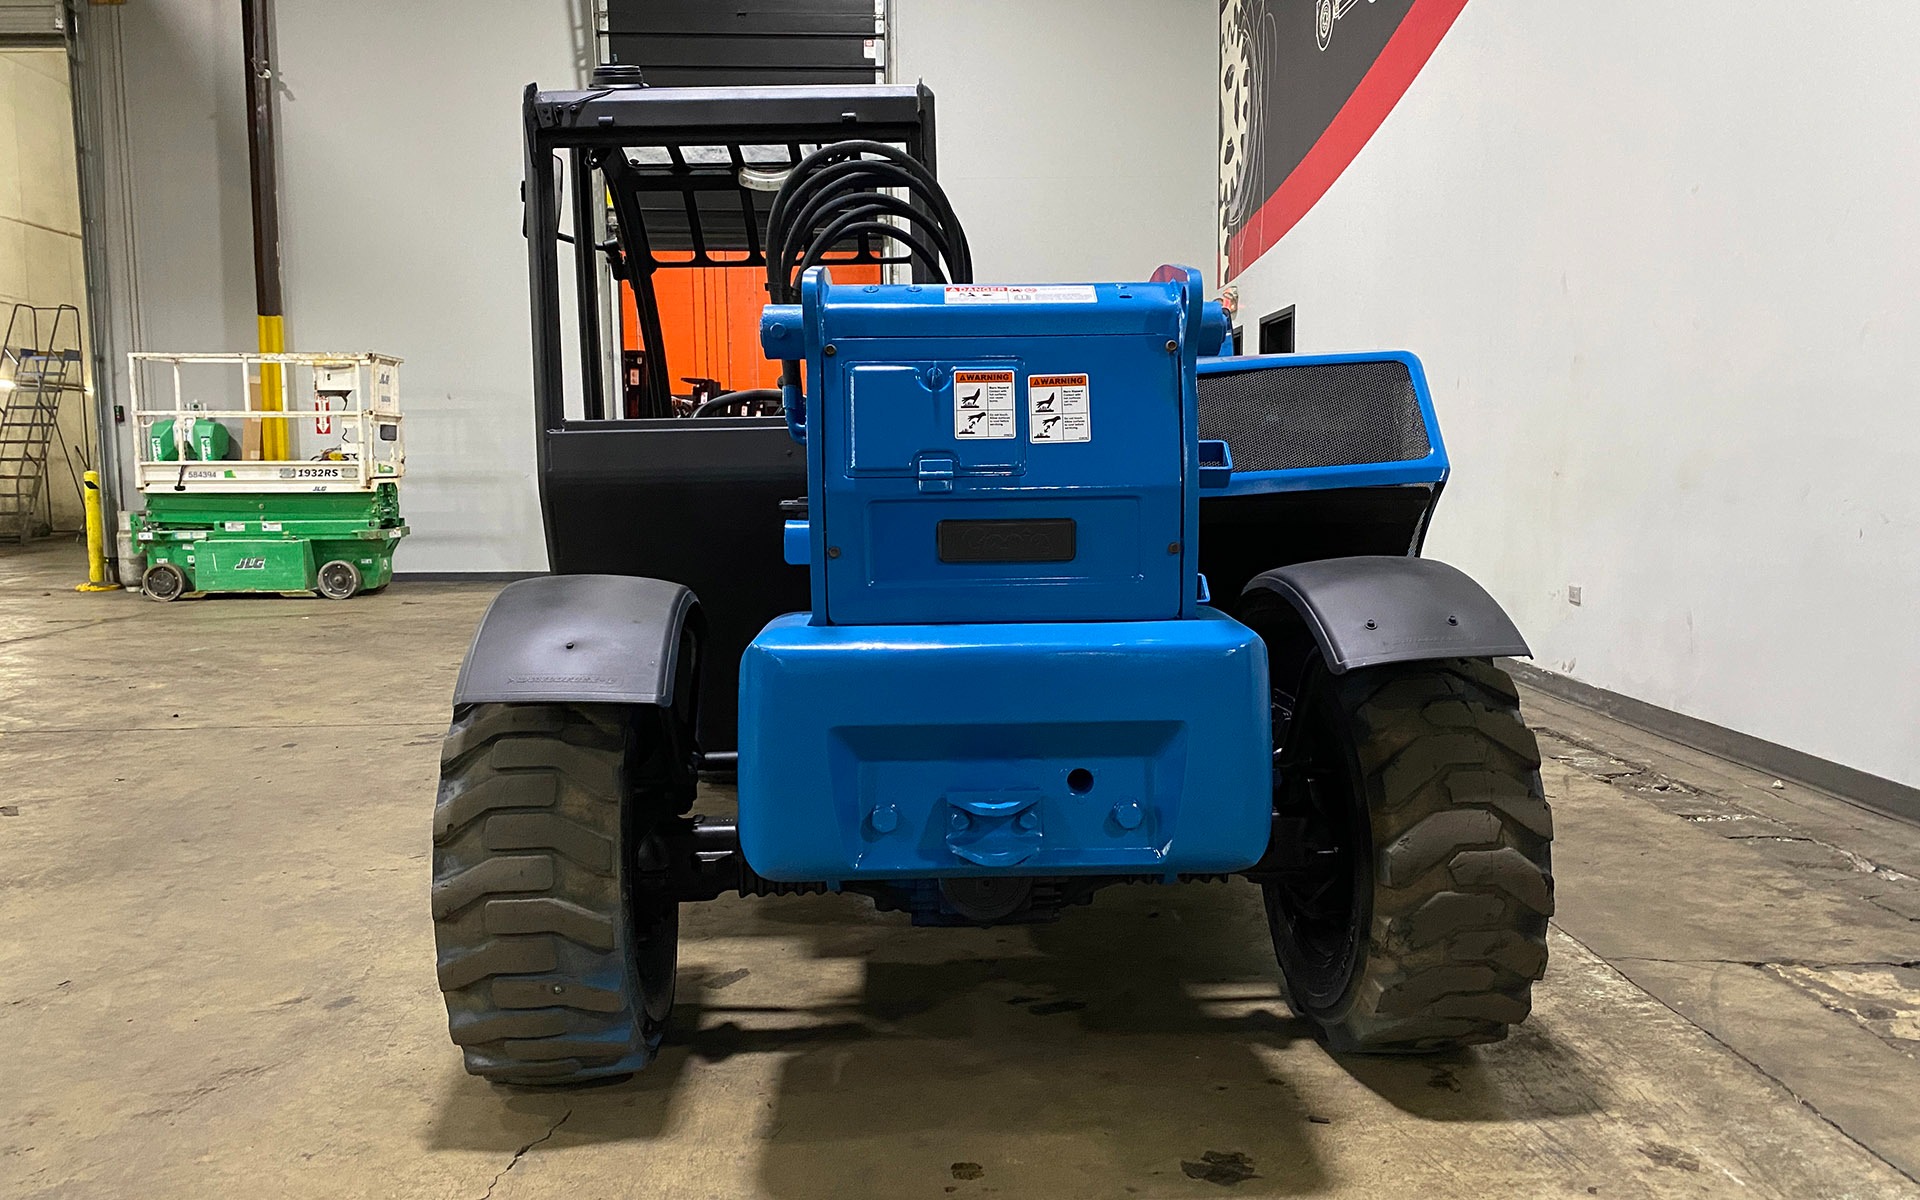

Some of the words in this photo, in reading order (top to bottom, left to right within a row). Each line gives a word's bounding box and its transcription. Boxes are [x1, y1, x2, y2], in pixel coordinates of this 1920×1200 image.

[1040, 377, 1083, 385] WARNING
[298, 468, 338, 477] 1932RS
[234, 557, 266, 570] JLG
